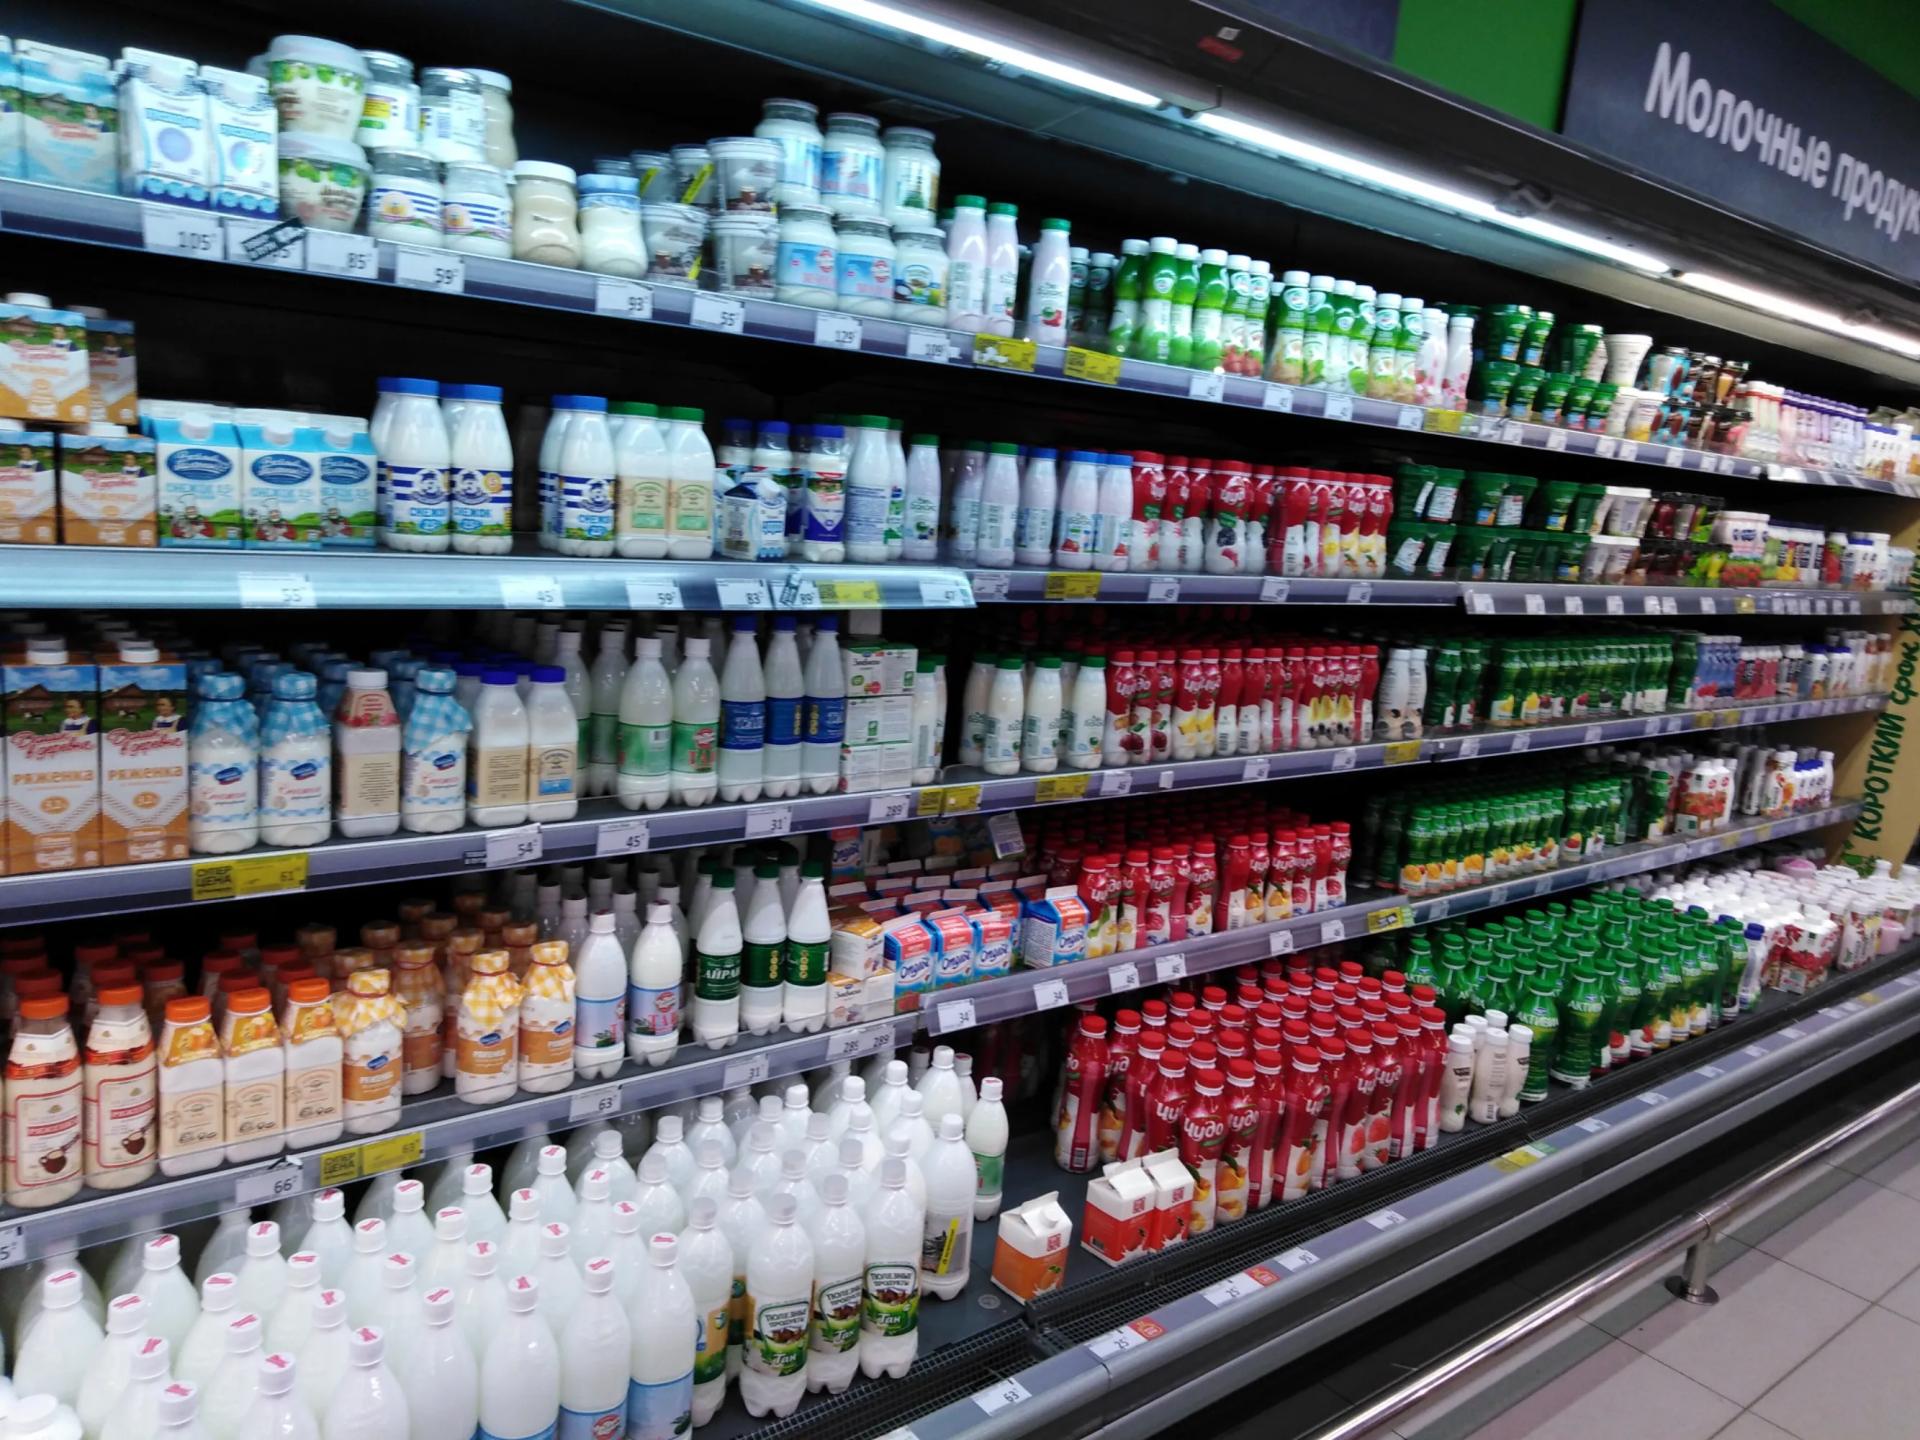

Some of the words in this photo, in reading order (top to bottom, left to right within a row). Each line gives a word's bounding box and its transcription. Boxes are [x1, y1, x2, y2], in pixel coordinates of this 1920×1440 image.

[1644, 42, 1831, 188] Молочные
[626, 835, 641, 848] 45
[517, 842, 534, 857] 54
[1183, 1116, 1225, 1141] Чудо
[273, 1178, 293, 1194] 66
[878, 1313, 901, 1325] Тан
[774, 1352, 797, 1364] Тан
[1003, 1390, 1020, 1402] 63
